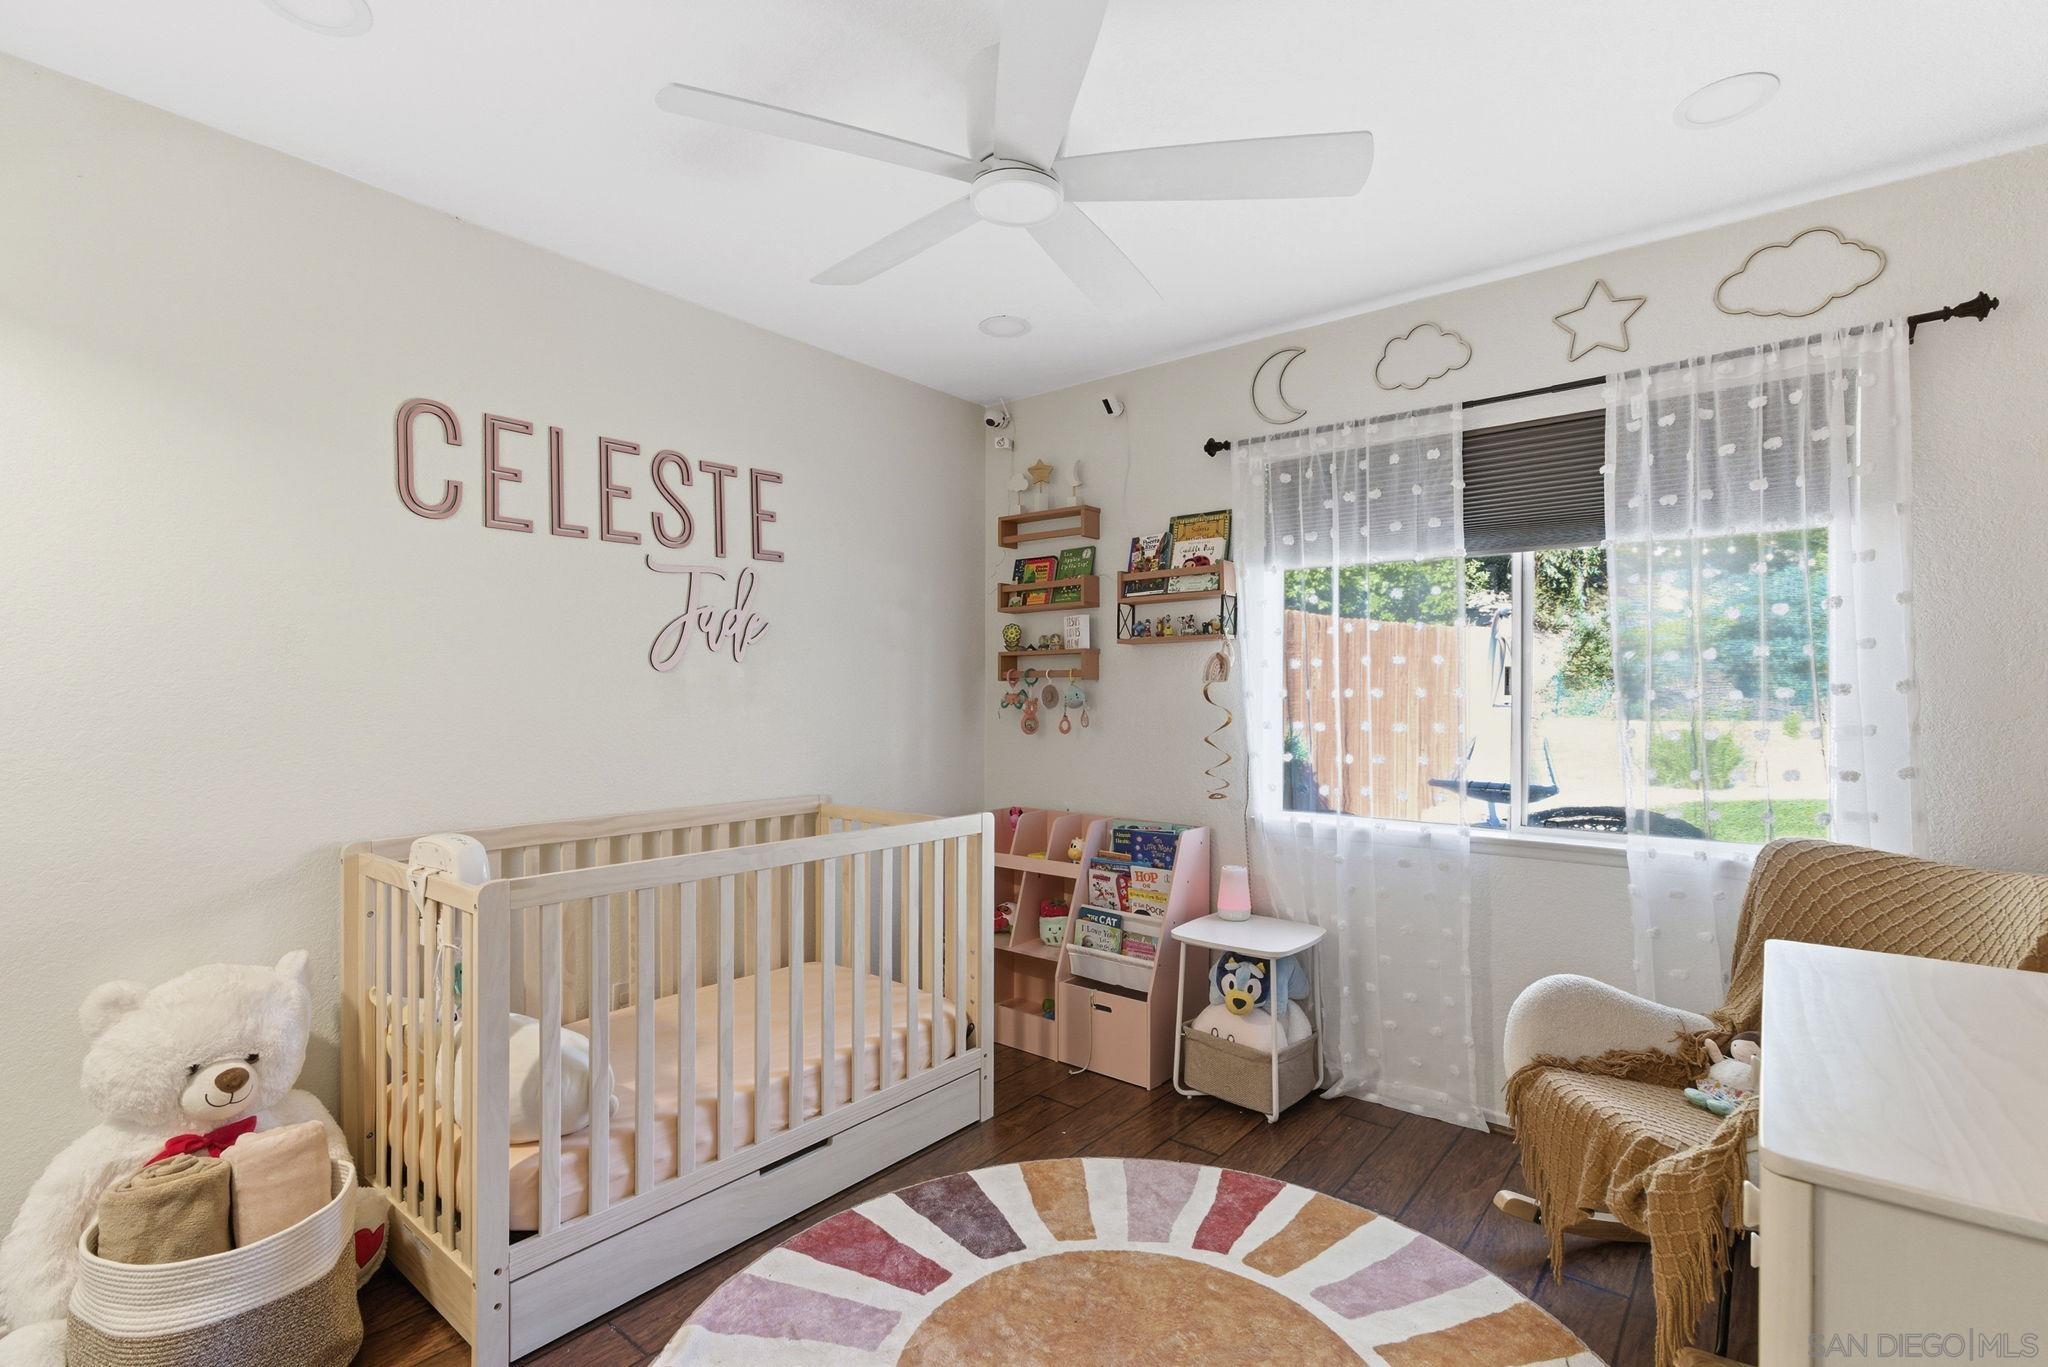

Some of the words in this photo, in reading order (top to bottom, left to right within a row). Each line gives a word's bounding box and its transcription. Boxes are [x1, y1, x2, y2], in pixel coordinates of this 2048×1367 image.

[396, 397, 785, 562] CELESTE
[645, 553, 769, 672] Jade
[1134, 870, 1158, 883] HOP
[1099, 915, 1118, 927] CAT
[1087, 925, 1102, 936] Love
